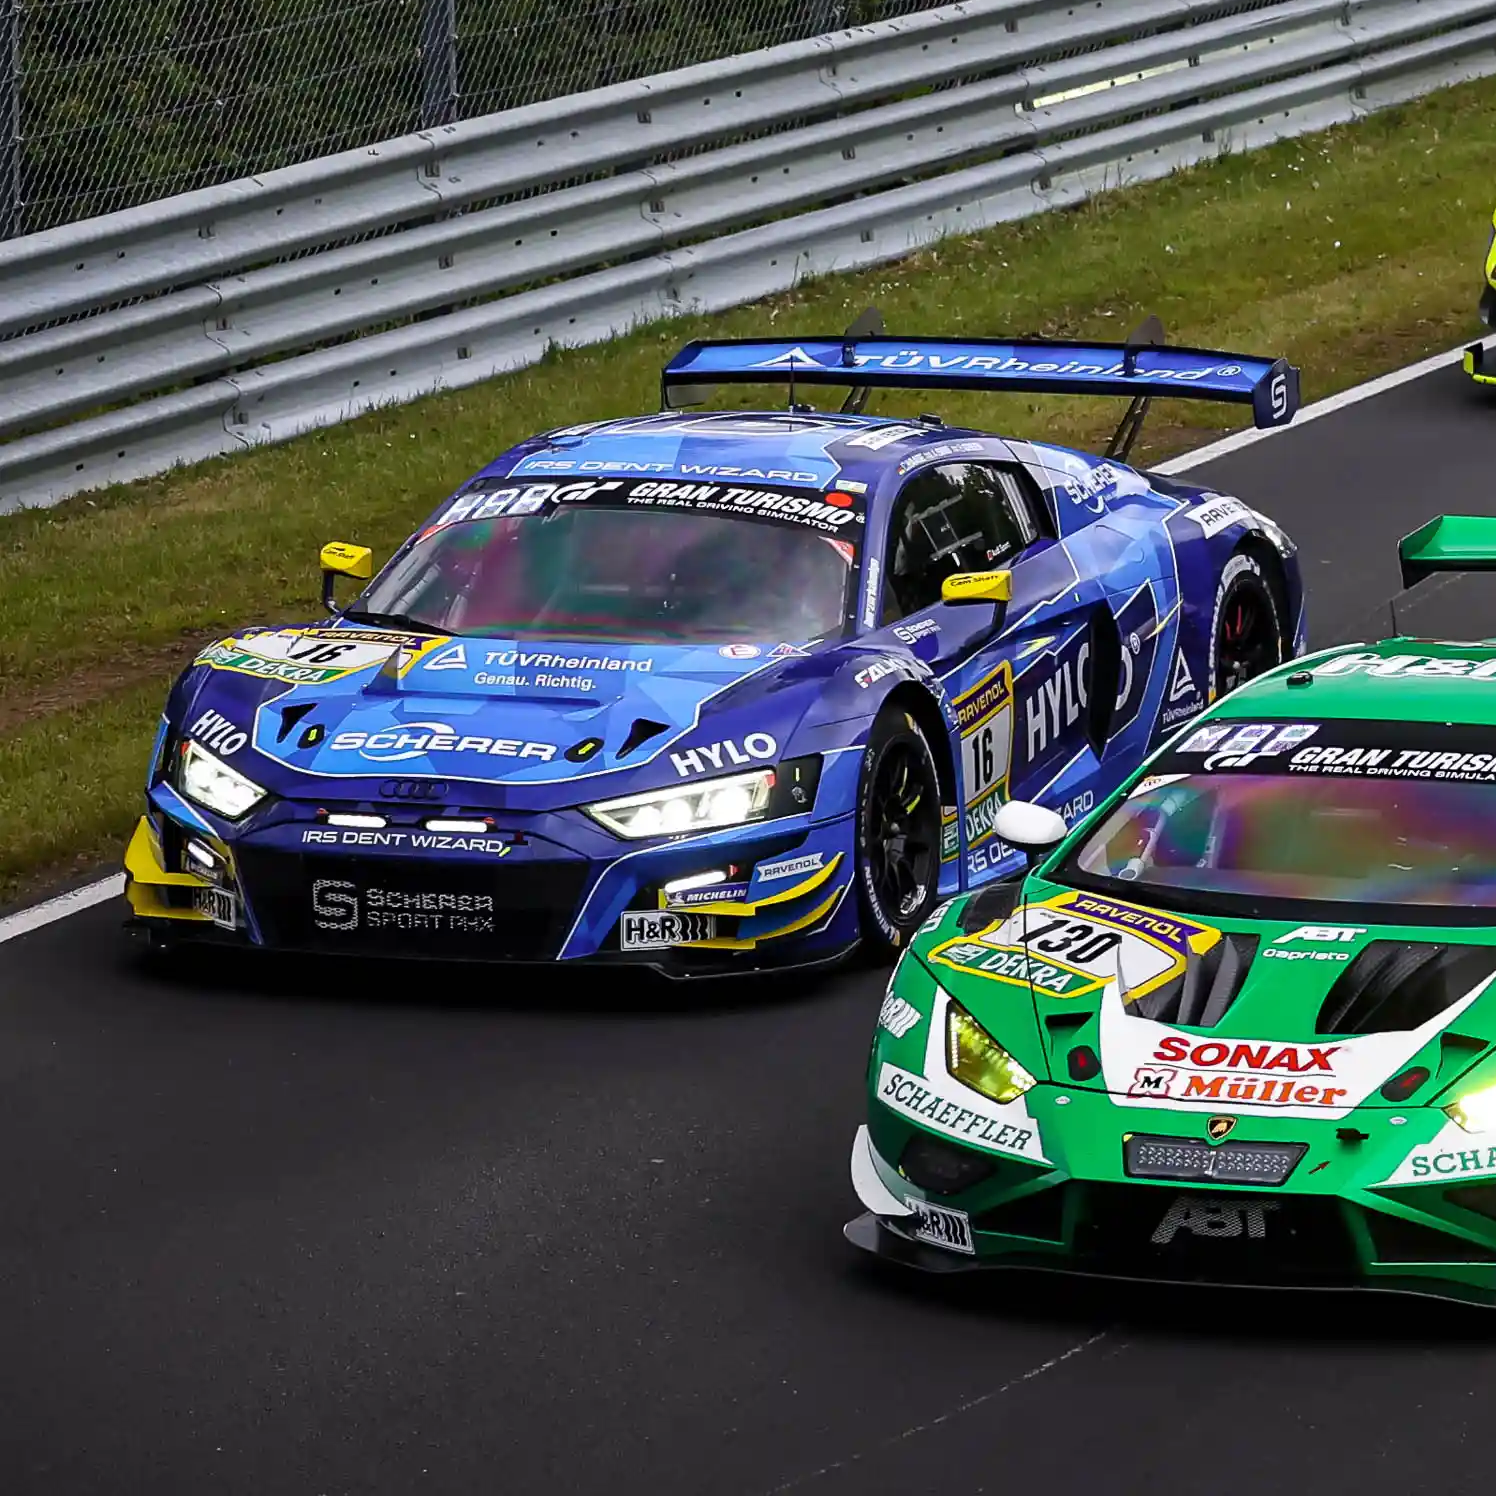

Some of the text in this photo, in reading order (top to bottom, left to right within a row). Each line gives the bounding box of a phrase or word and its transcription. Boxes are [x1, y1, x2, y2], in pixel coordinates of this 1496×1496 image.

[523, 459, 819, 484] IRS DENT WIZARD
[627, 497, 840, 534] THE REAL DRIVING SIMULATOR
[628, 481, 720, 504] GRAN
[720, 486, 855, 526] TURISMO
[294, 640, 349, 665] 16
[318, 629, 420, 648] RAVENOL
[243, 654, 334, 684] DEKRA
[484, 648, 654, 673] TÜVRheinland
[473, 672, 597, 692] Genau. Richtig.
[956, 677, 1007, 727] RAVENOL
[189, 708, 249, 756] HYLO
[330, 730, 558, 762] SCHERER
[669, 732, 778, 778] HYLO
[970, 717, 995, 794] 16
[1290, 746, 1392, 766] GRAN
[1288, 763, 1319, 773] THE
[1322, 764, 1363, 775] REAL
[1366, 766, 1432, 778] DRIVING
[963, 791, 1004, 843] DEKRA
[301, 829, 503, 854] IRS DENT WIZARD
[763, 857, 820, 877] RAVENOL
[966, 847, 987, 875] RS
[365, 888, 495, 913] SCHERER
[686, 886, 748, 904] MICHELIN
[367, 911, 440, 932] SPORT
[625, 916, 676, 943] H&R
[1074, 897, 1187, 944] RAVENOL
[1271, 925, 1369, 945] ABT
[1016, 917, 1124, 967] 130
[979, 950, 1075, 996] DEKRA
[1153, 1035, 1343, 1073] SONAX
[1182, 1073, 1348, 1106] Müller
[881, 1072, 1034, 1152] SCHAEFFLER
[1149, 1197, 1281, 1246] ABT
